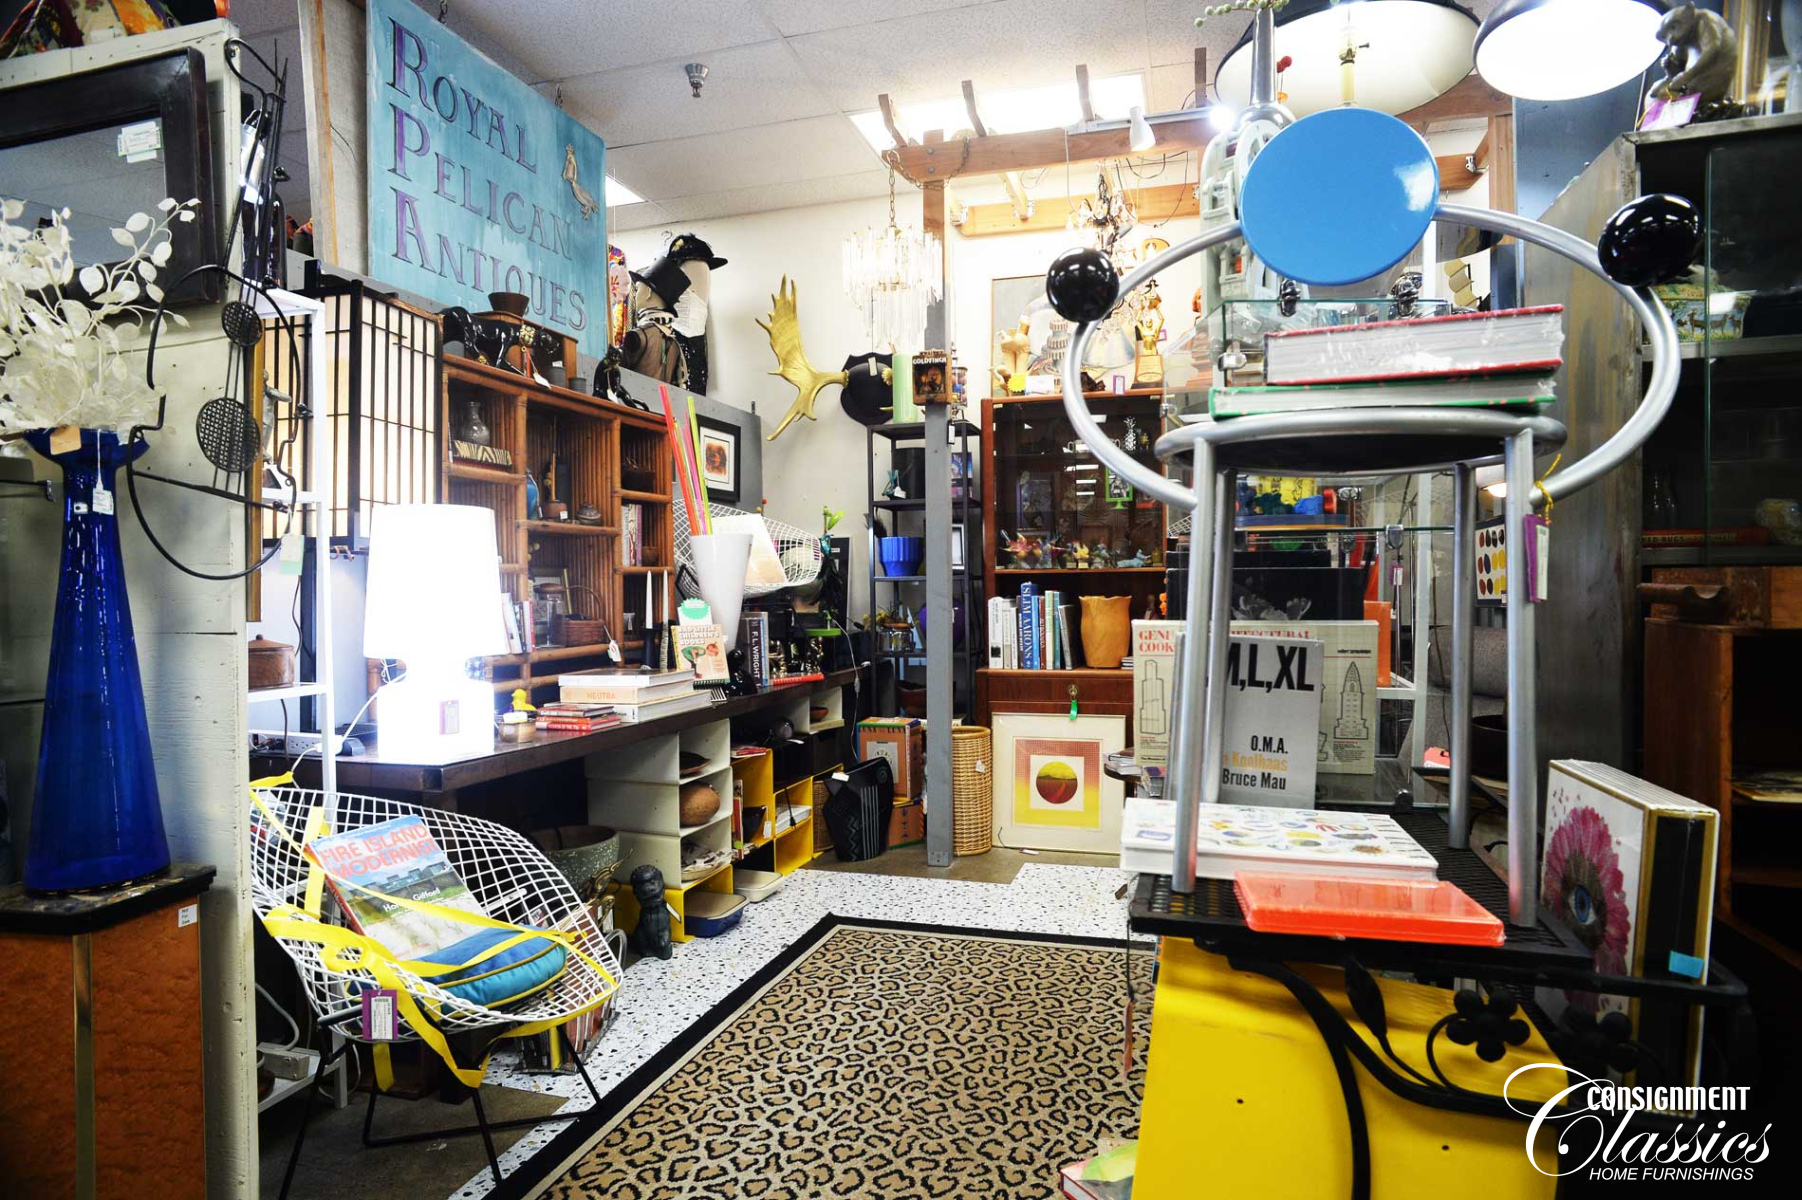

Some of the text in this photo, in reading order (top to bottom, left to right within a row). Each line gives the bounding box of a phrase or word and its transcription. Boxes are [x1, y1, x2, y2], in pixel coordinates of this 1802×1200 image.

[386, 16, 538, 174] ROYAL
[387, 102, 572, 260] PELICAN
[389, 186, 587, 332] ANTIQUES
[1022, 587, 1033, 659] SLIM AARONS
[1138, 641, 1175, 653] COOK
[586, 691, 616, 700] NEUTRA
[1250, 735, 1289, 755] O.M.A.
[1231, 750, 1288, 773] Koolhaas
[1221, 768, 1287, 790] Bruce Mau
[319, 842, 359, 866] FIRE
[364, 823, 429, 853] ISLAND
[328, 837, 440, 880] MODERNIST
[412, 887, 441, 901] Gifford
[383, 903, 400, 912] Hor
